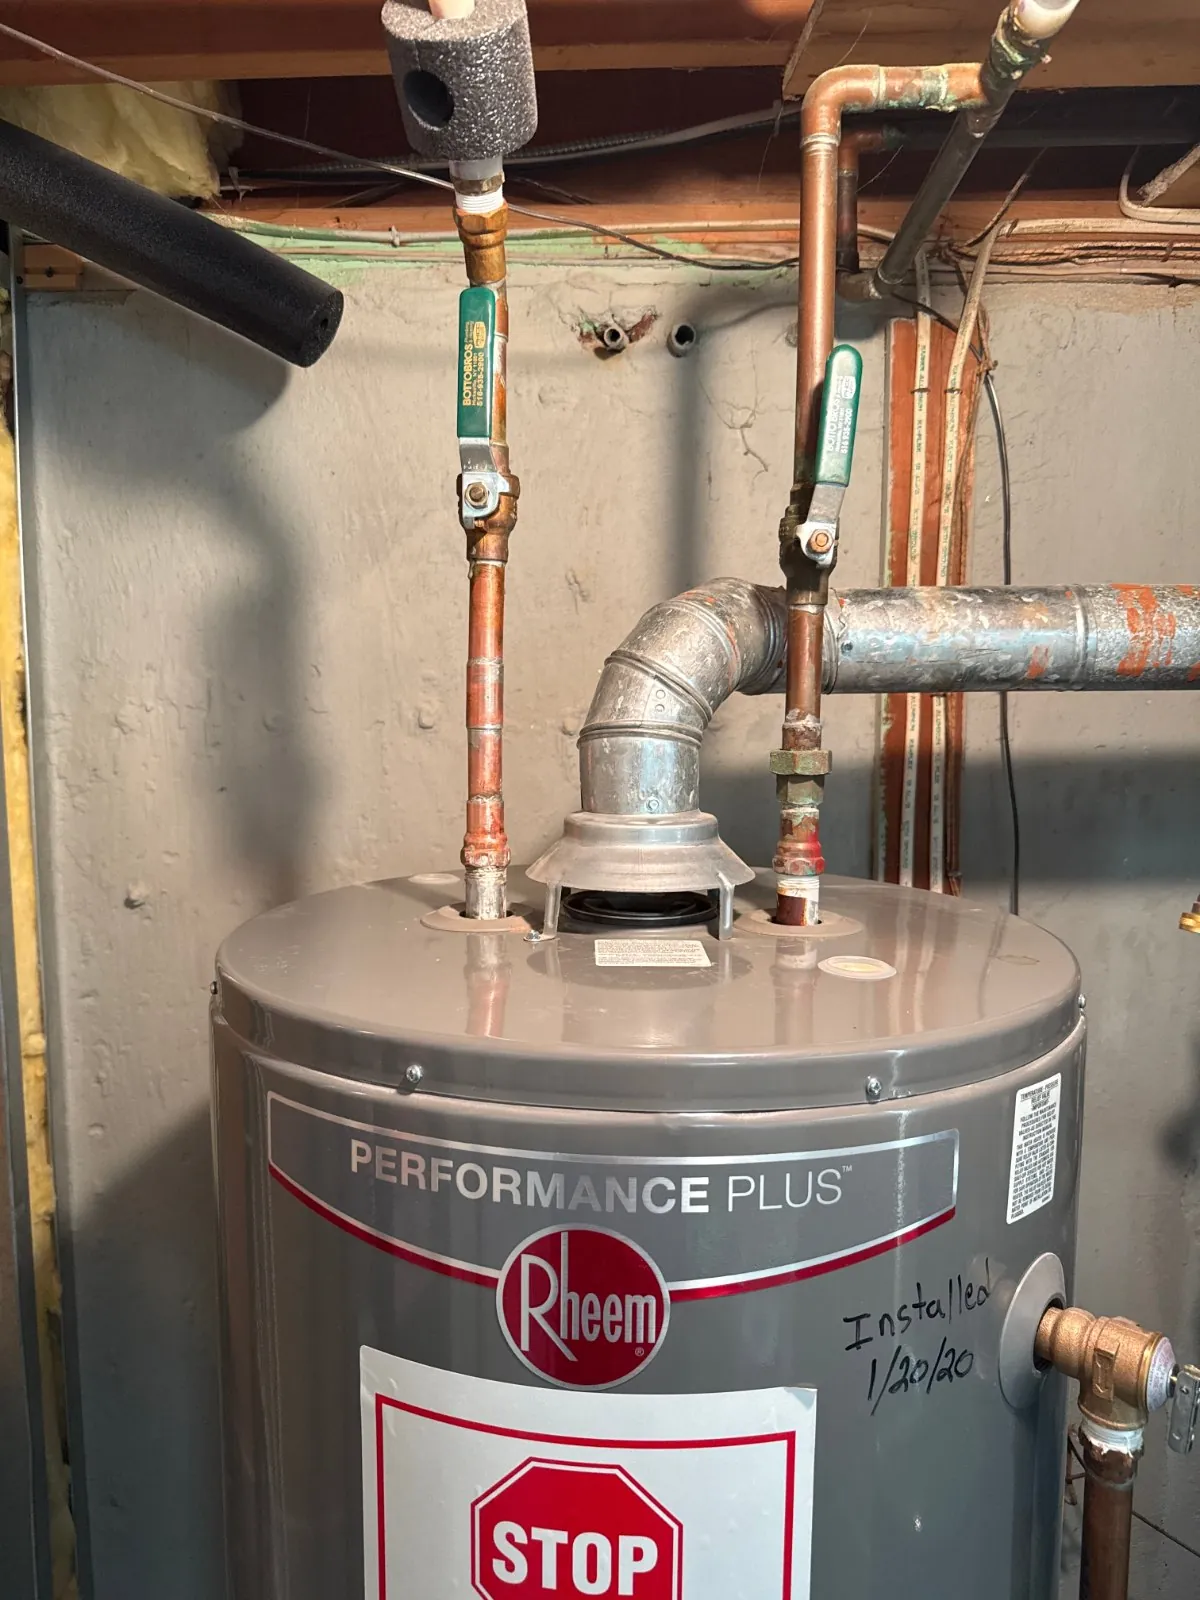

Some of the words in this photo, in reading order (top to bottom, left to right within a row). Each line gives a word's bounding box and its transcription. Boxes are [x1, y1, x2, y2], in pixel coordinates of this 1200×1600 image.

[350, 1138, 709, 1214] PERFORMANCE
[520, 1232, 656, 1362] Rheem
[843, 1257, 991, 1351] Installed
[867, 1336, 974, 1416] 1/20/20
[492, 1520, 658, 1596] STOP
